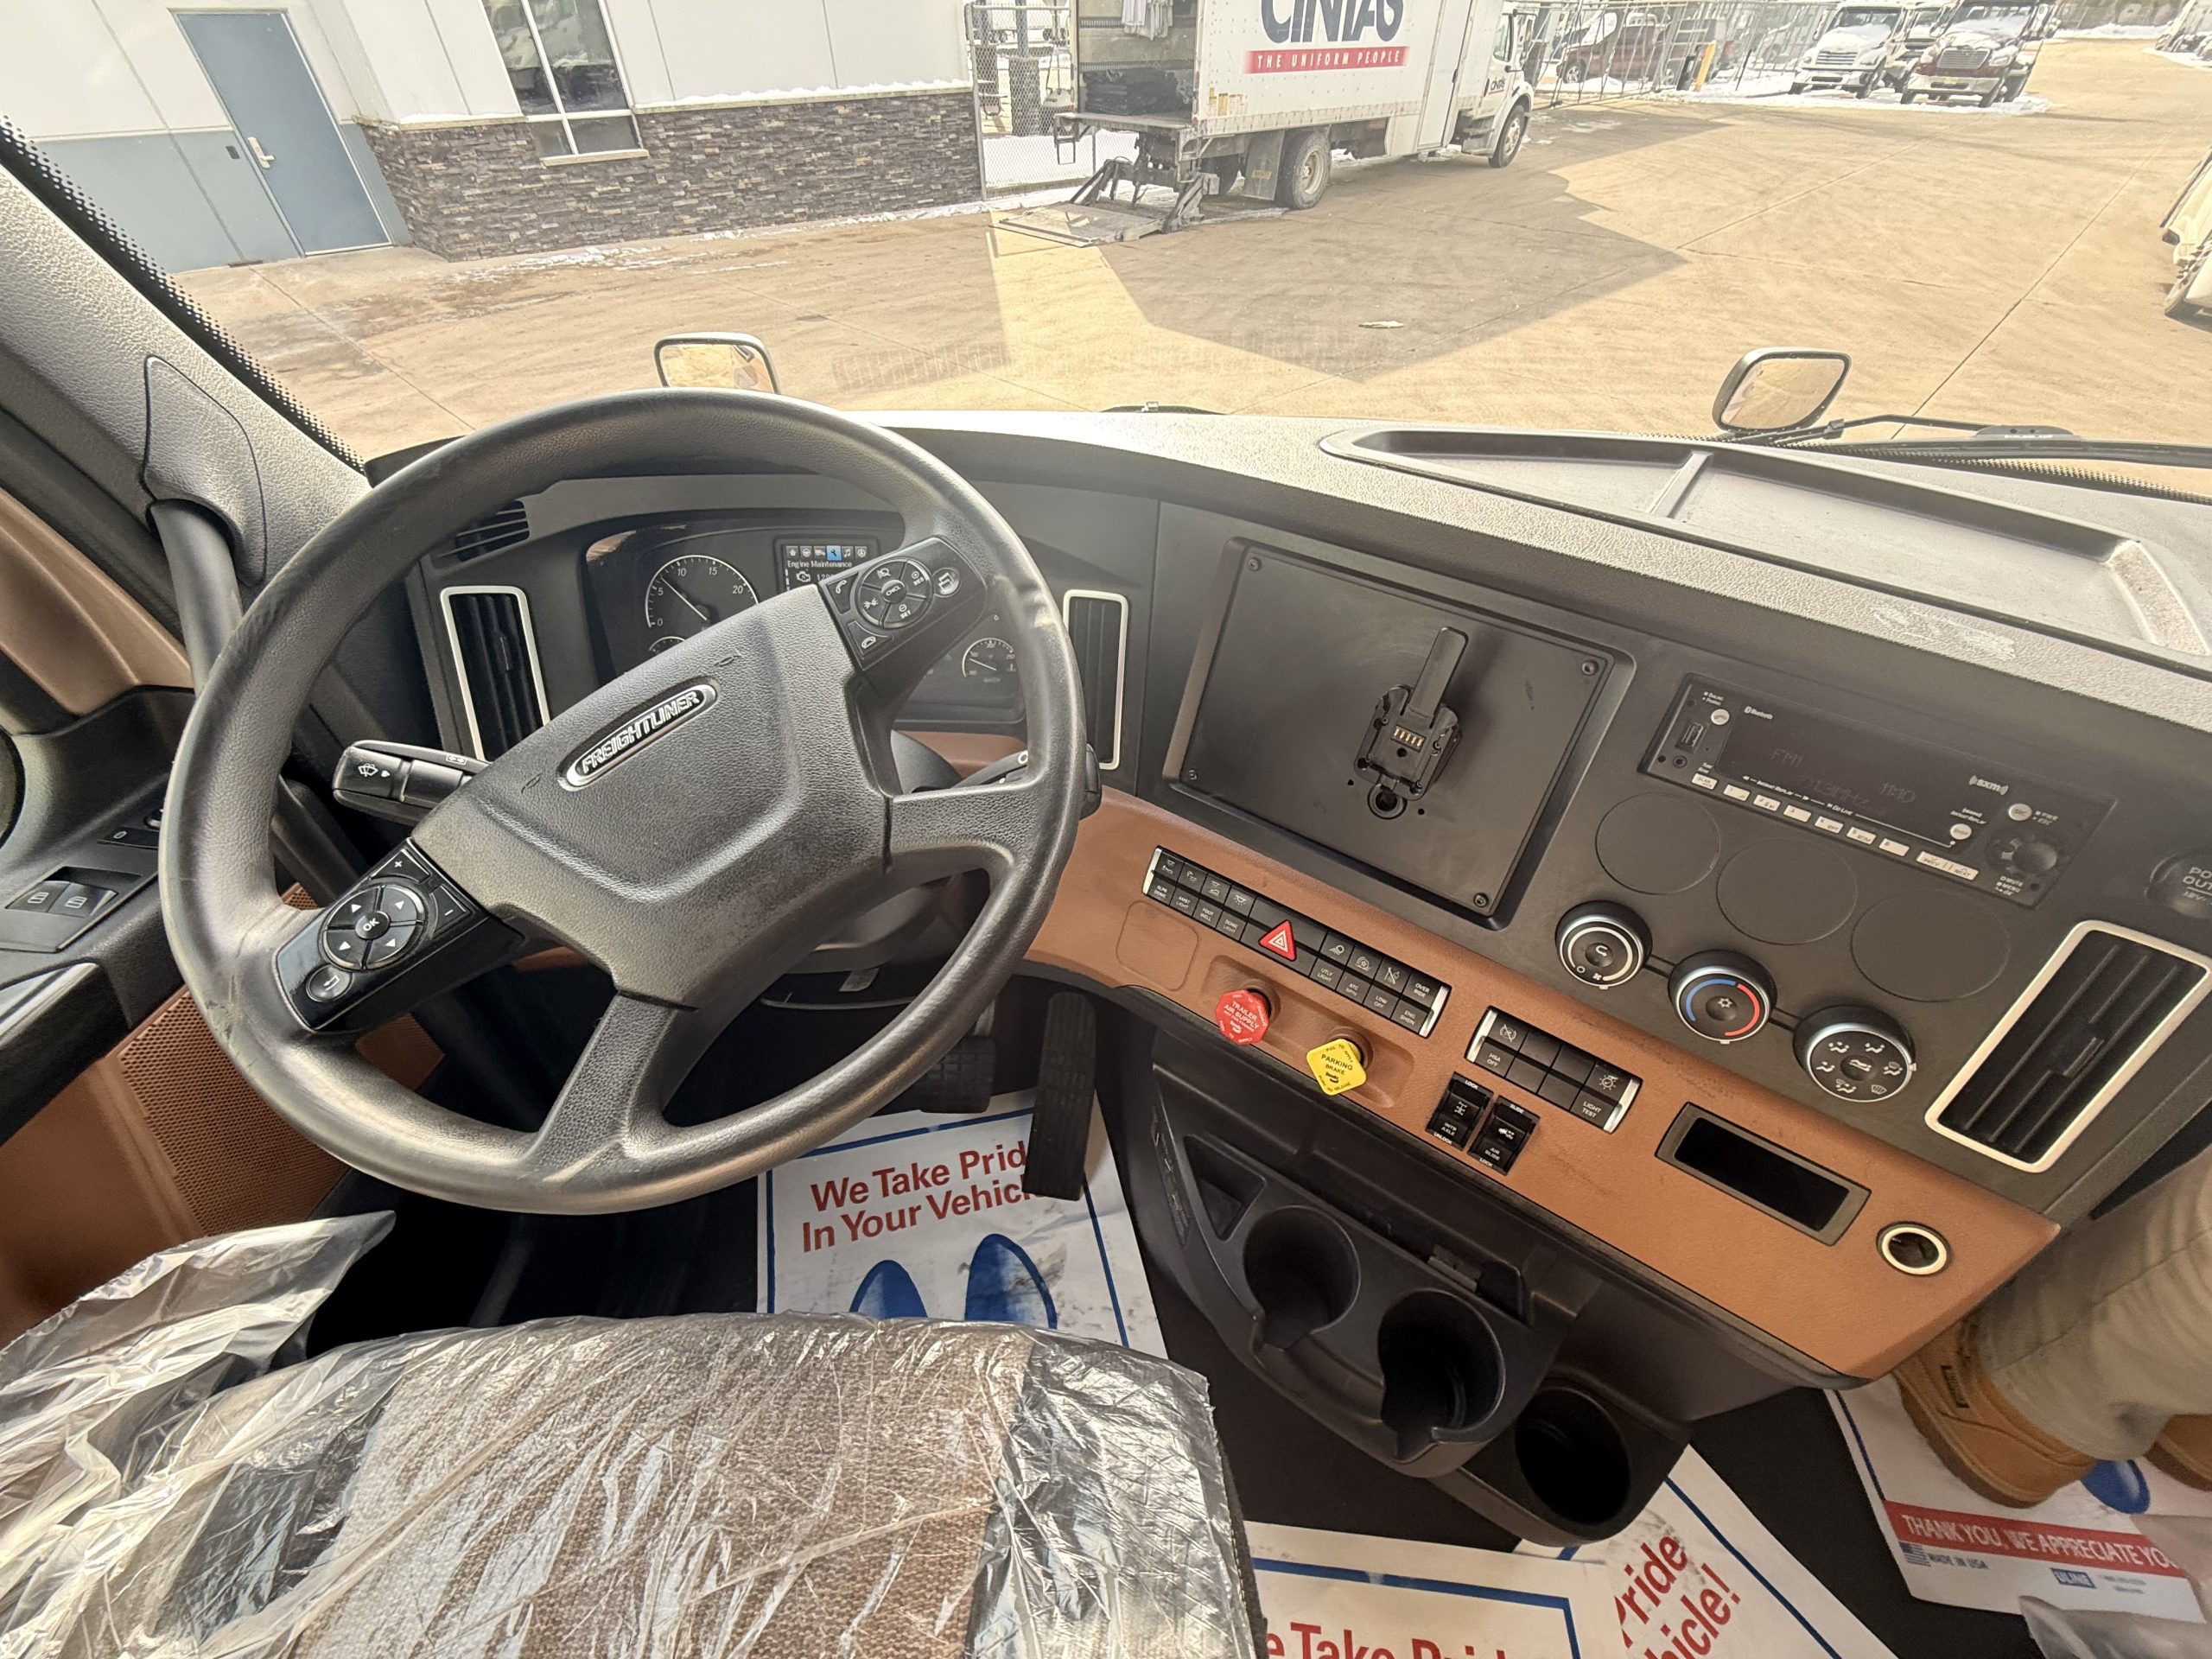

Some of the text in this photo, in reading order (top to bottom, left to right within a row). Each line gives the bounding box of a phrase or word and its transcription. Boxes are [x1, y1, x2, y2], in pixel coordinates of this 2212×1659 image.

[1258, 50, 1400, 68] THE UNIFORM PEOPLE
[787, 560, 810, 569] Engine
[677, 568, 686, 577] 10
[709, 567, 718, 575] 15
[658, 587, 664, 596] 5
[733, 586, 743, 594] 20
[886, 586, 900, 596] CNCL
[900, 610, 912, 620] SET
[582, 690, 700, 773] FREIGHTLINER
[2006, 878, 2024, 887] MUTE
[2001, 883, 2021, 893] MENU
[1200, 913, 1211, 922] WELL
[363, 918, 380, 931] OK
[1223, 925, 1236, 934] LIGHT
[1225, 919, 1239, 930] DOME
[1321, 968, 1333, 976] UTLY
[1317, 973, 1332, 982] LIGHT
[1414, 983, 1430, 993] OVER
[1414, 988, 1426, 998] RIDE
[1374, 1001, 1384, 1009] OFF
[1232, 1001, 1257, 1021] TRAILER
[1404, 1010, 1415, 1020] ENG
[1224, 1004, 1260, 1030] AIR SUPPLY
[1400, 1015, 1415, 1026] SHDN
[1489, 1052, 1501, 1062] HSA
[1320, 1054, 1353, 1071] PARKING
[1486, 1058, 1498, 1067] OFF
[1325, 1064, 1344, 1075] BRAKE
[1465, 1079, 1479, 1090] LOCK
[1583, 1101, 1602, 1113] LIGHT
[1582, 1108, 1597, 1118] TEST
[1441, 1127, 1455, 1136] AXLE
[1434, 1132, 1452, 1145] UNLOCK
[1484, 1149, 1500, 1161] SLIDE
[1479, 1158, 1493, 1167] LOCK
[810, 1141, 1027, 1211] We Take Prid
[802, 1222, 836, 1253] In
[840, 1204, 922, 1243] Your
[1901, 1514, 2179, 1569] THANK YOU, WE APPRECIATE YO
[1615, 1536, 1688, 1649] ride
